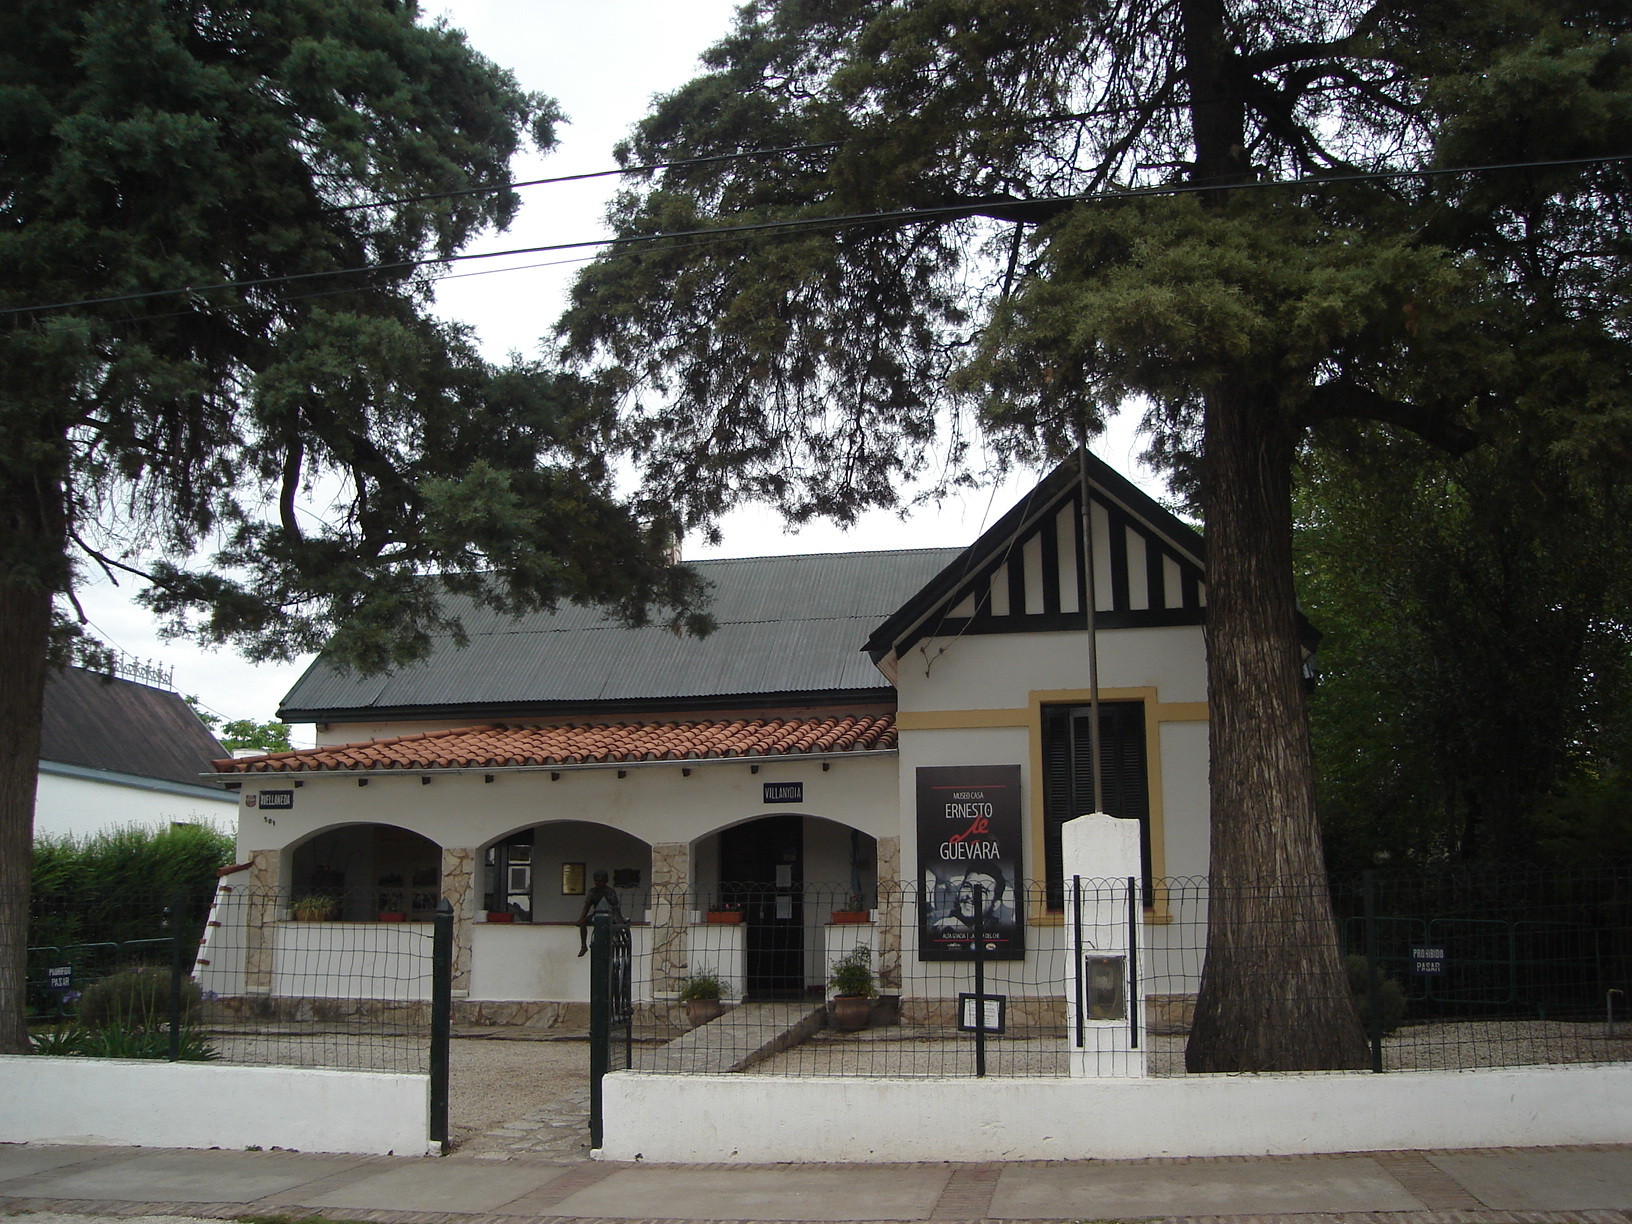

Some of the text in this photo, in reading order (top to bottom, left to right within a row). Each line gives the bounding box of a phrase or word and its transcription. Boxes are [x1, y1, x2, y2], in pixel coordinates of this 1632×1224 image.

[953, 792, 971, 800] MUSEO
[945, 803, 993, 818] ERNESTO
[940, 841, 1000, 860] GUEVARA
[1413, 949, 1444, 959] PROHIBIDO
[1416, 962, 1441, 972] PASAR
[51, 976, 70, 987] PASAR
